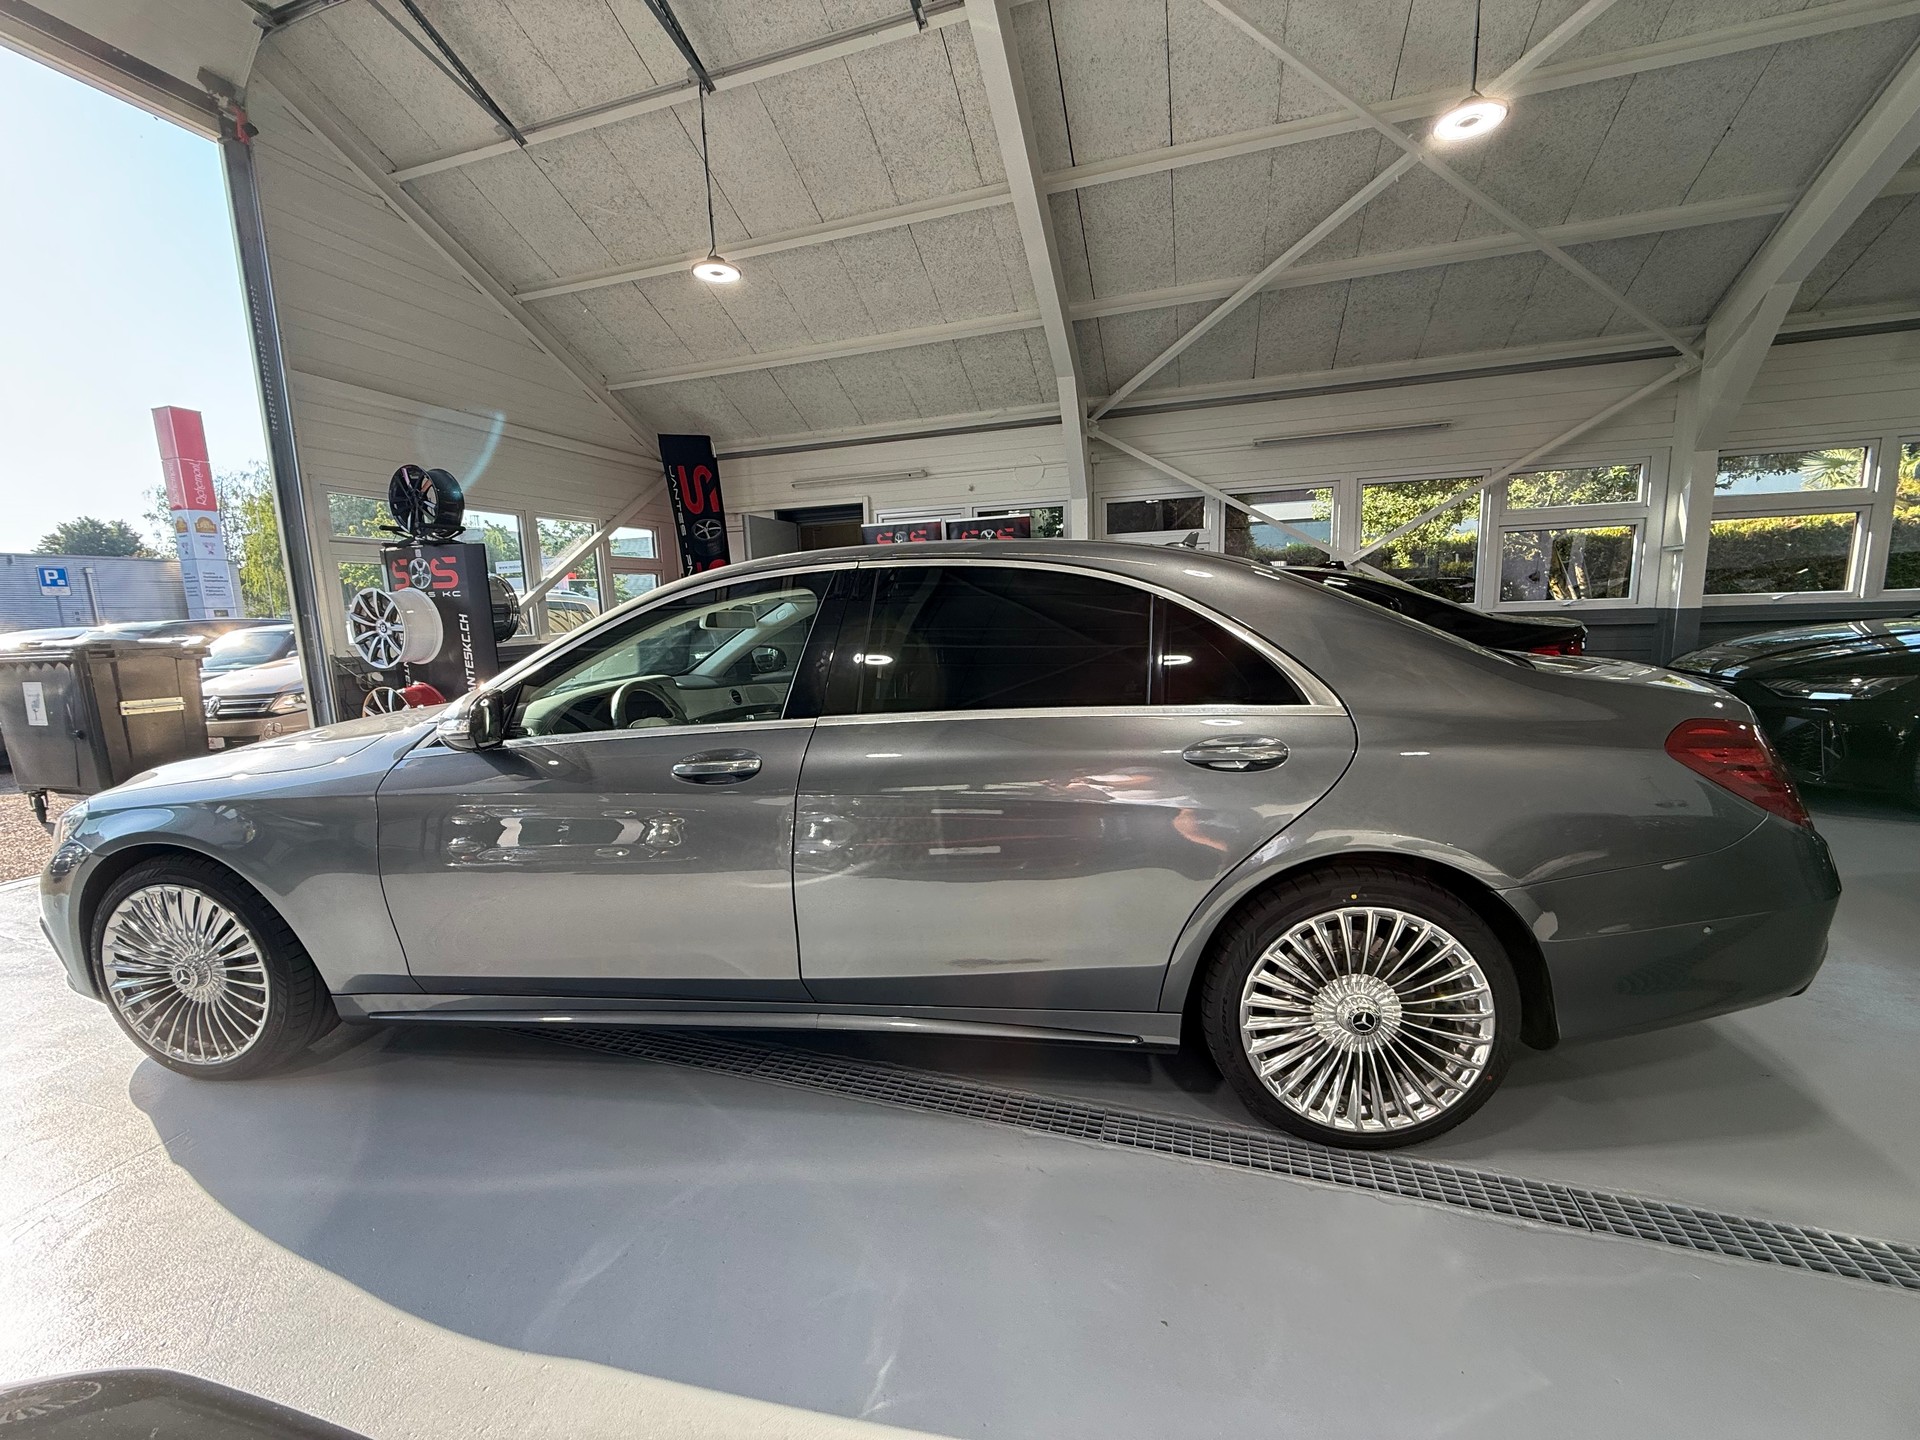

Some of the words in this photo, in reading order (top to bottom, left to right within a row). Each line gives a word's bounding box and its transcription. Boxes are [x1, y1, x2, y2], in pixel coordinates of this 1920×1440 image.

[668, 465, 687, 536] JANTES
[43, 569, 58, 584] P
[458, 613, 477, 692] ANTESKC.CH
